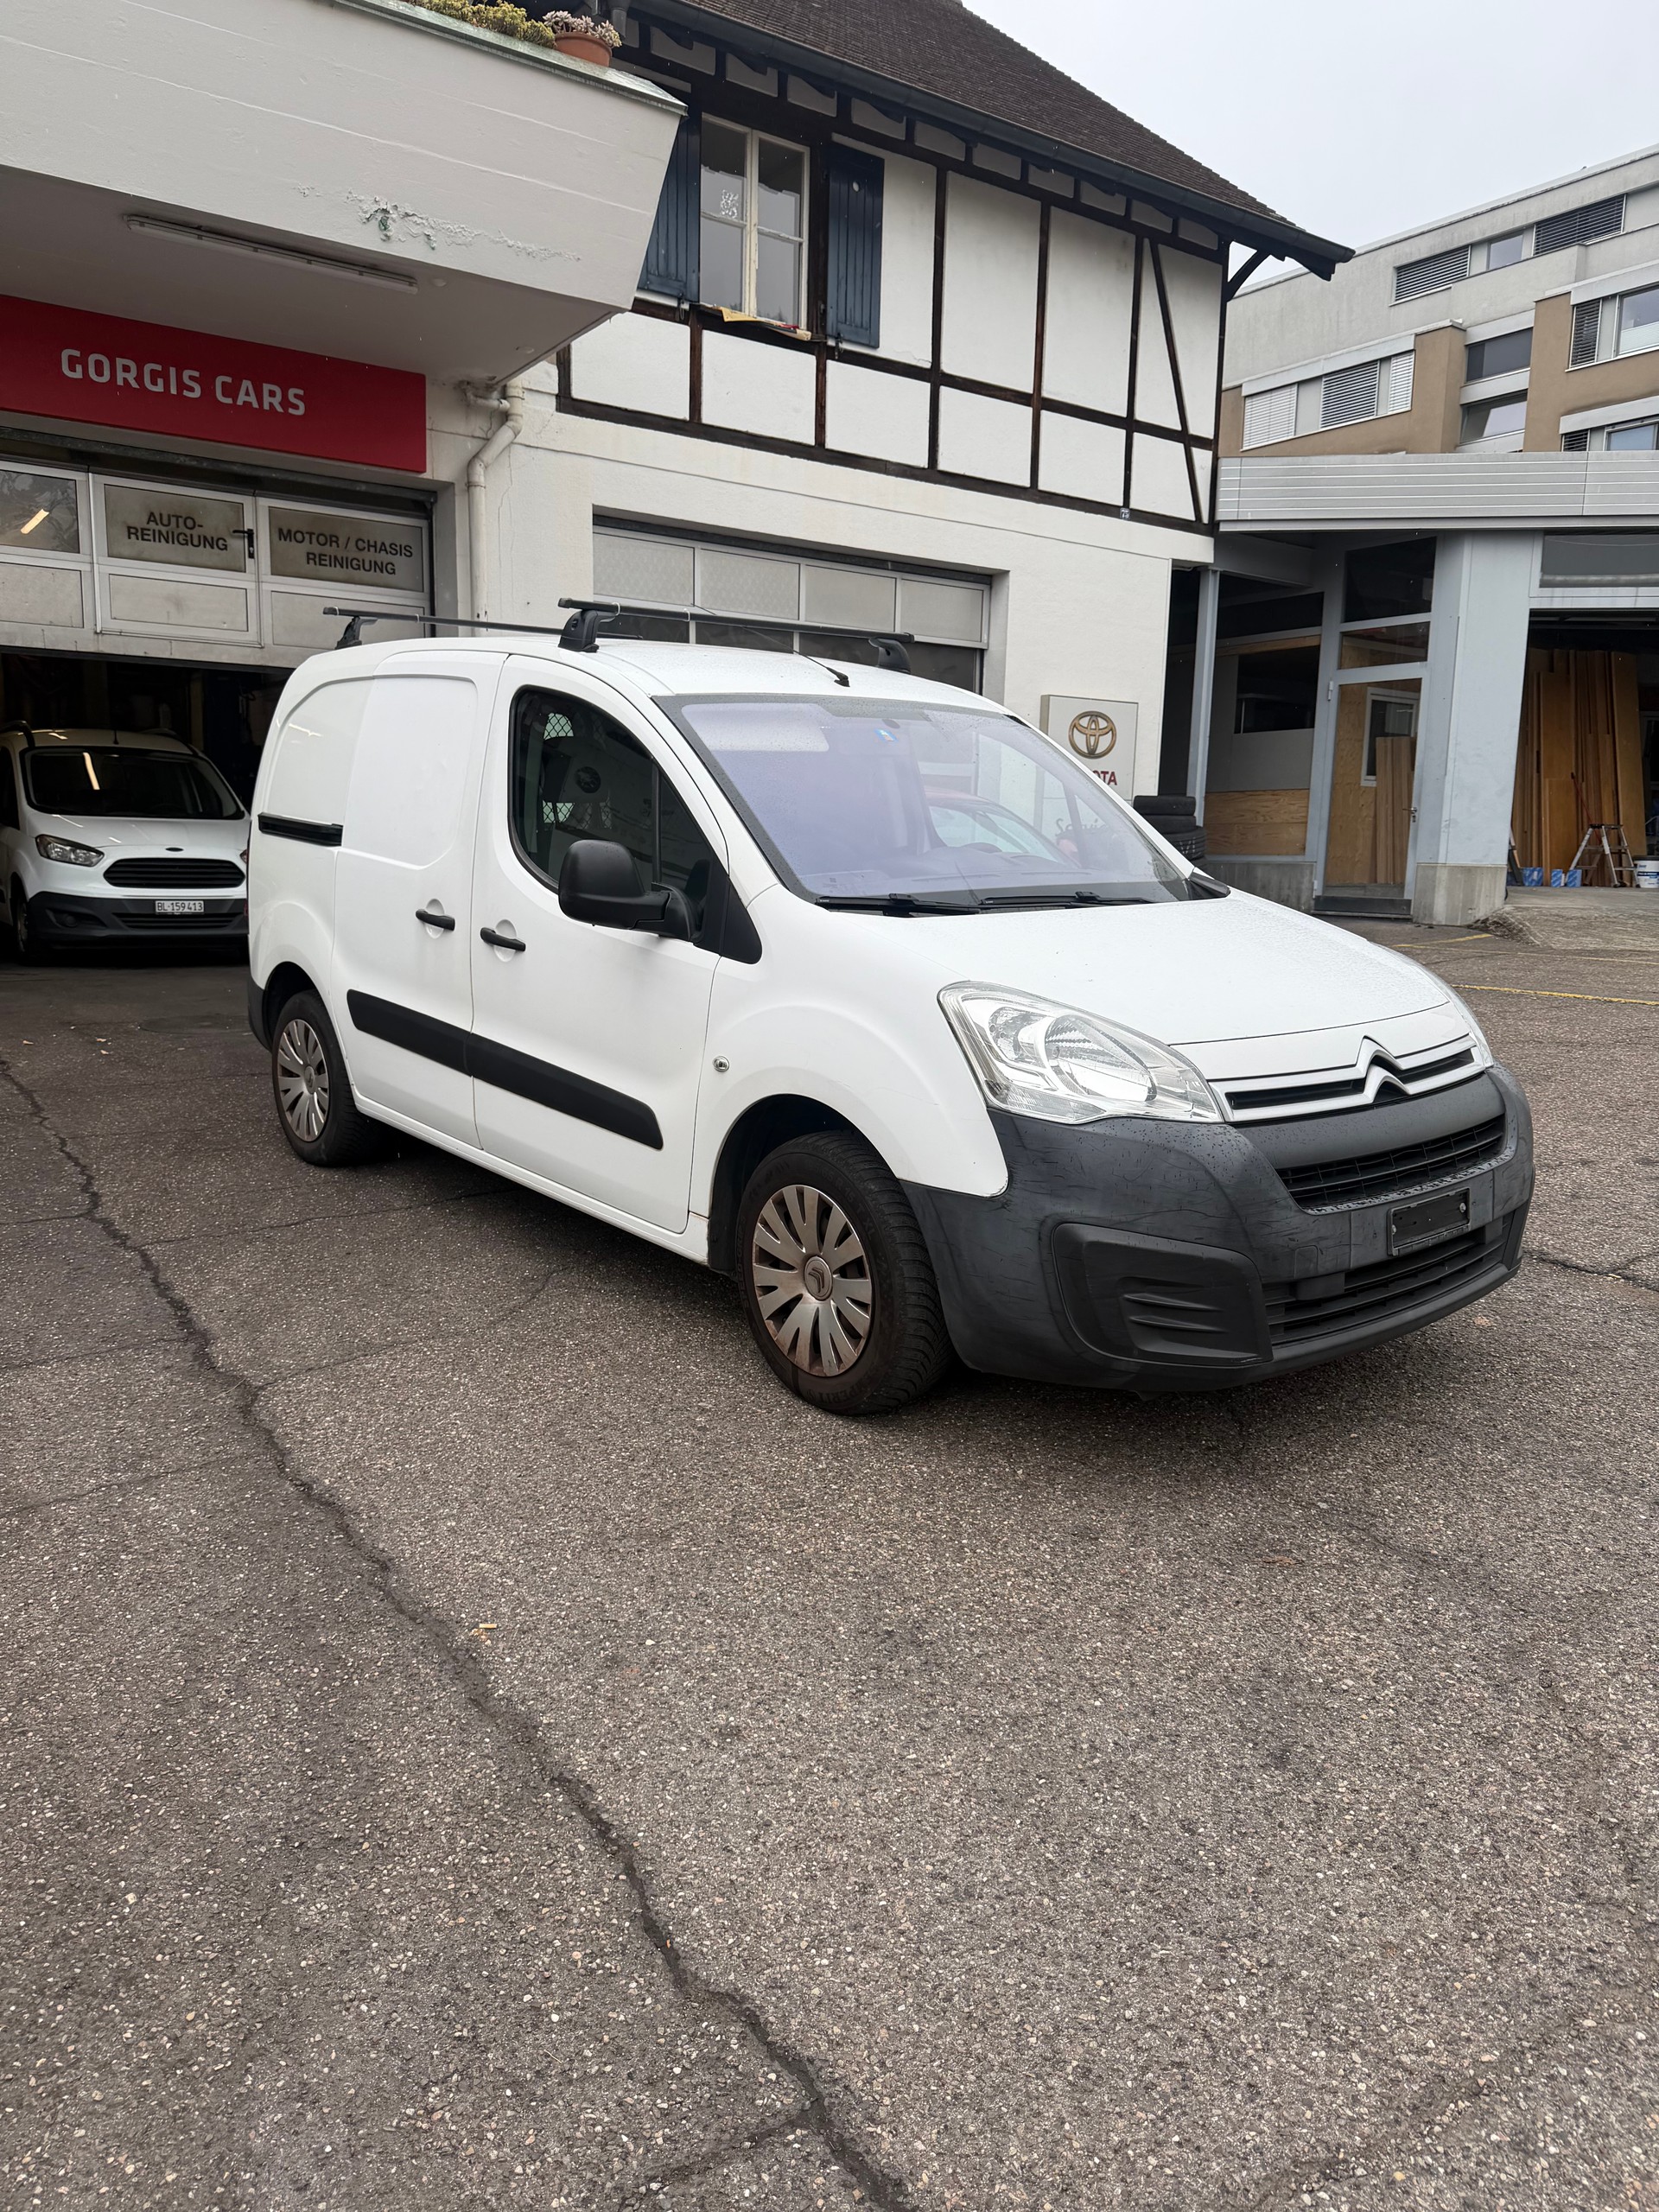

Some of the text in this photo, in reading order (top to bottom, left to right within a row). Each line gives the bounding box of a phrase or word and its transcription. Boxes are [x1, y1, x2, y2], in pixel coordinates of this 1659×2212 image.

[61, 348, 306, 416] GORGIS CARS
[146, 512, 204, 531] AUTO-
[126, 525, 228, 551] REINIGUNG
[277, 527, 340, 549] MOTOR
[354, 537, 413, 558] CHASIS
[306, 551, 397, 575] REINIGUNG
